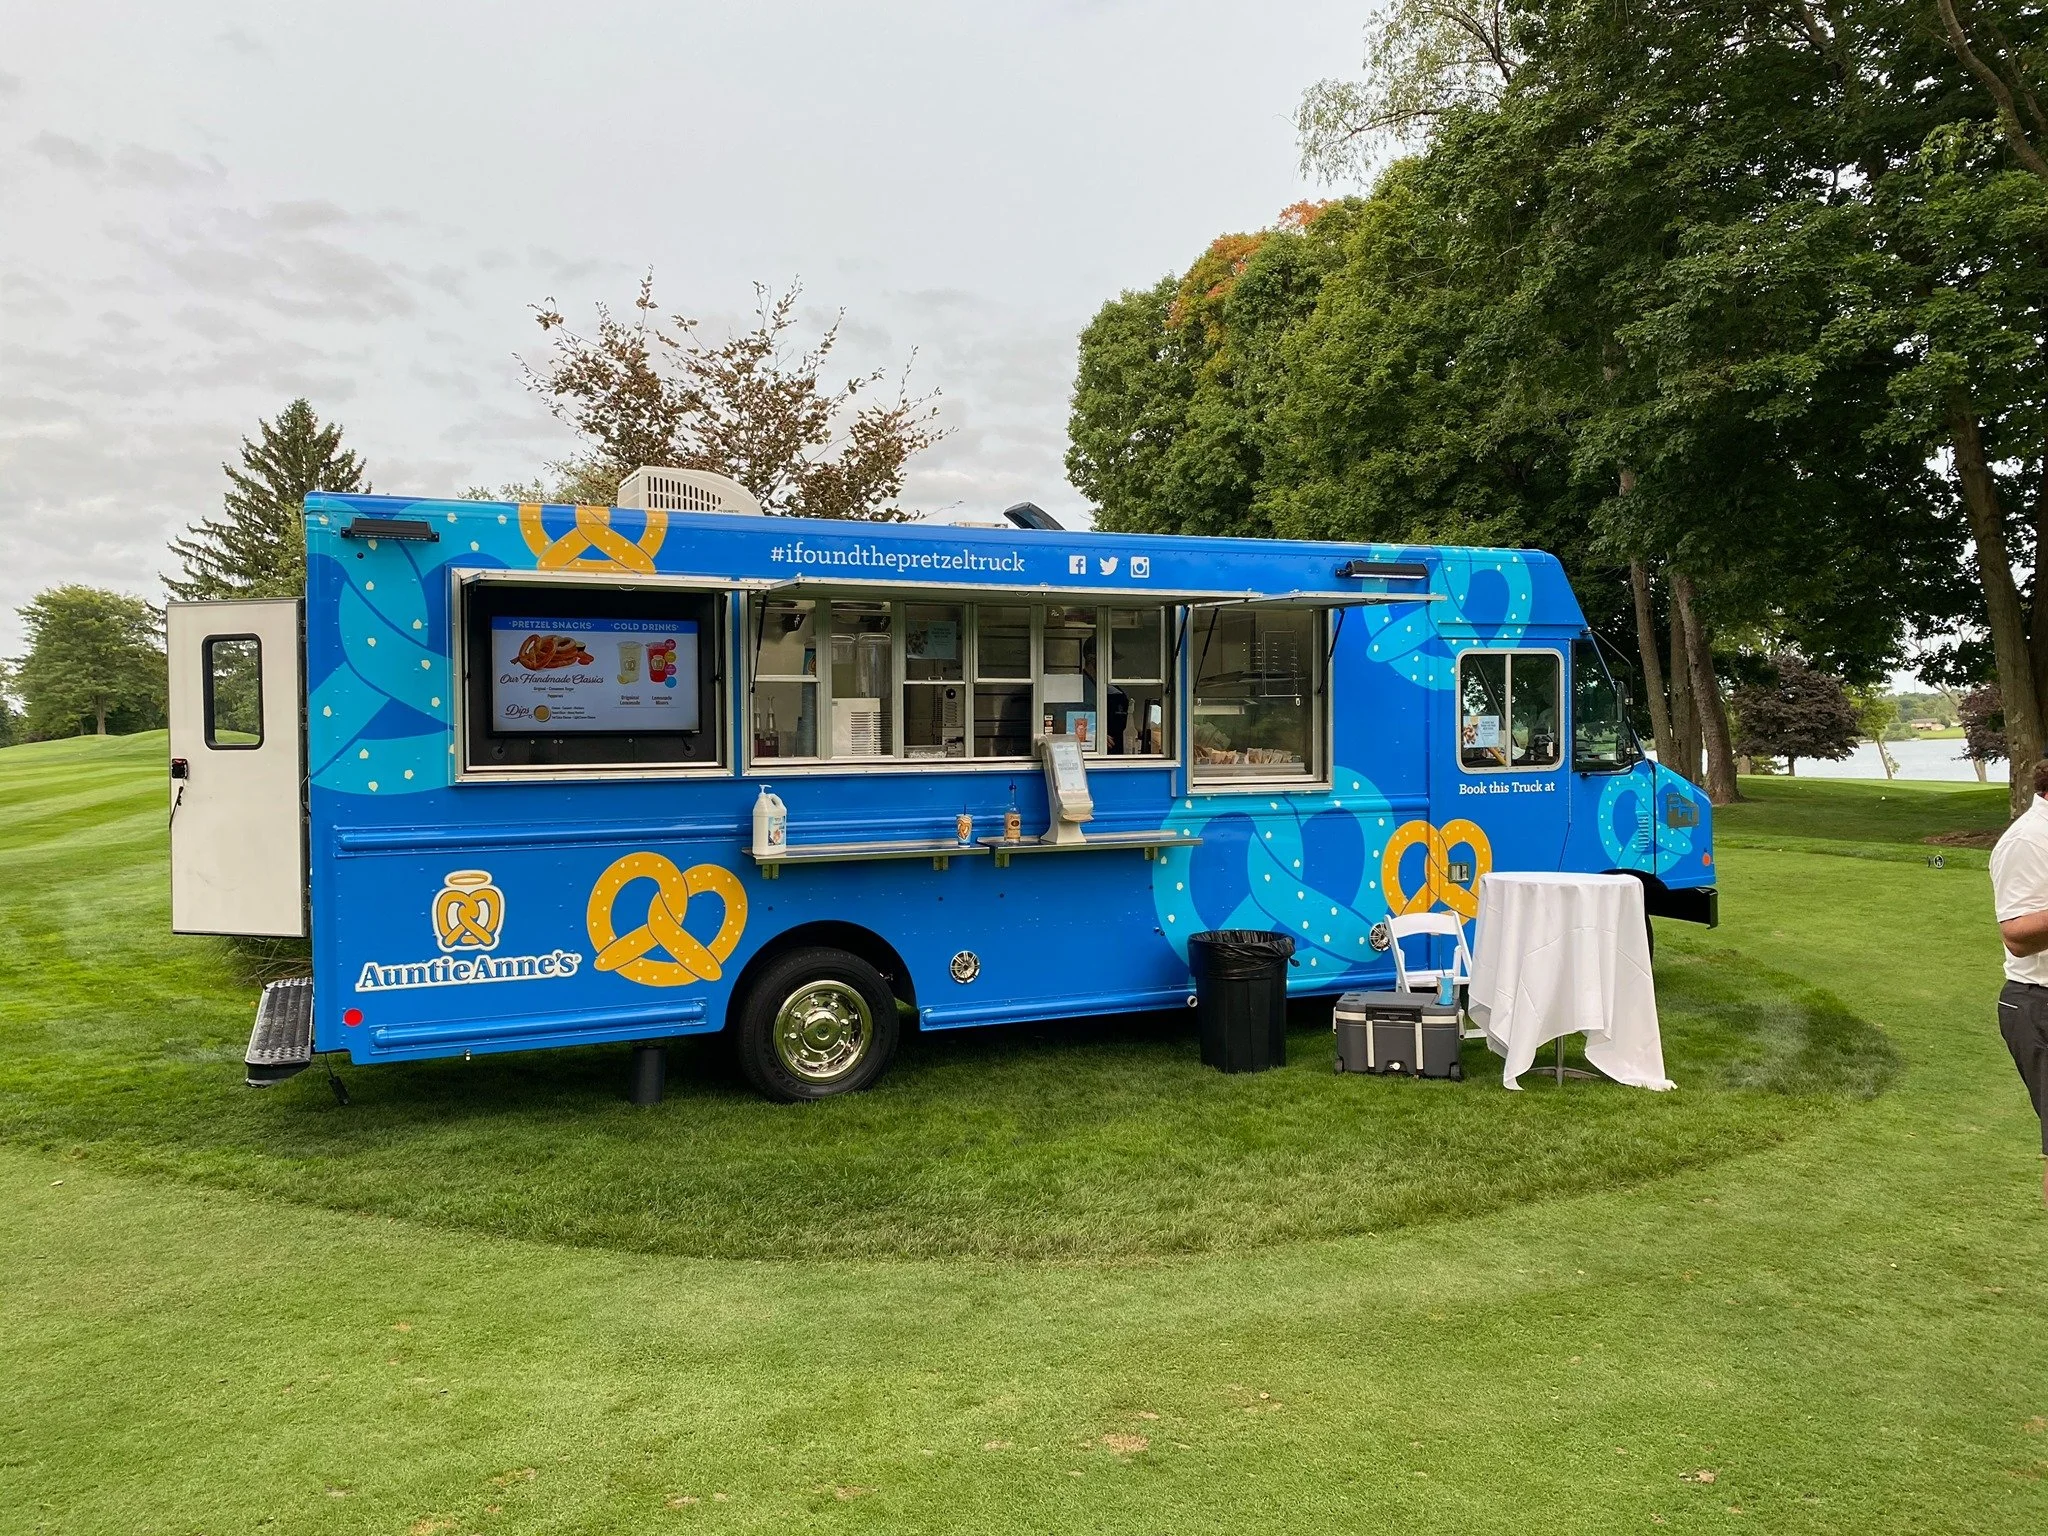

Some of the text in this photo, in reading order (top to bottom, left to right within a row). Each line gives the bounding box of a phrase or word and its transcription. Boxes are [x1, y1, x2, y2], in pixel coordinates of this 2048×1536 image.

[771, 542, 1025, 572] #ifoundthepretzeltruck
[512, 620, 592, 630] PRETZEL SNACKS
[613, 622, 677, 631] COLD DRINKS
[500, 673, 604, 685] Our Handmade Classics
[505, 704, 530, 716] Dips
[1459, 780, 1556, 794] Book this Truck at
